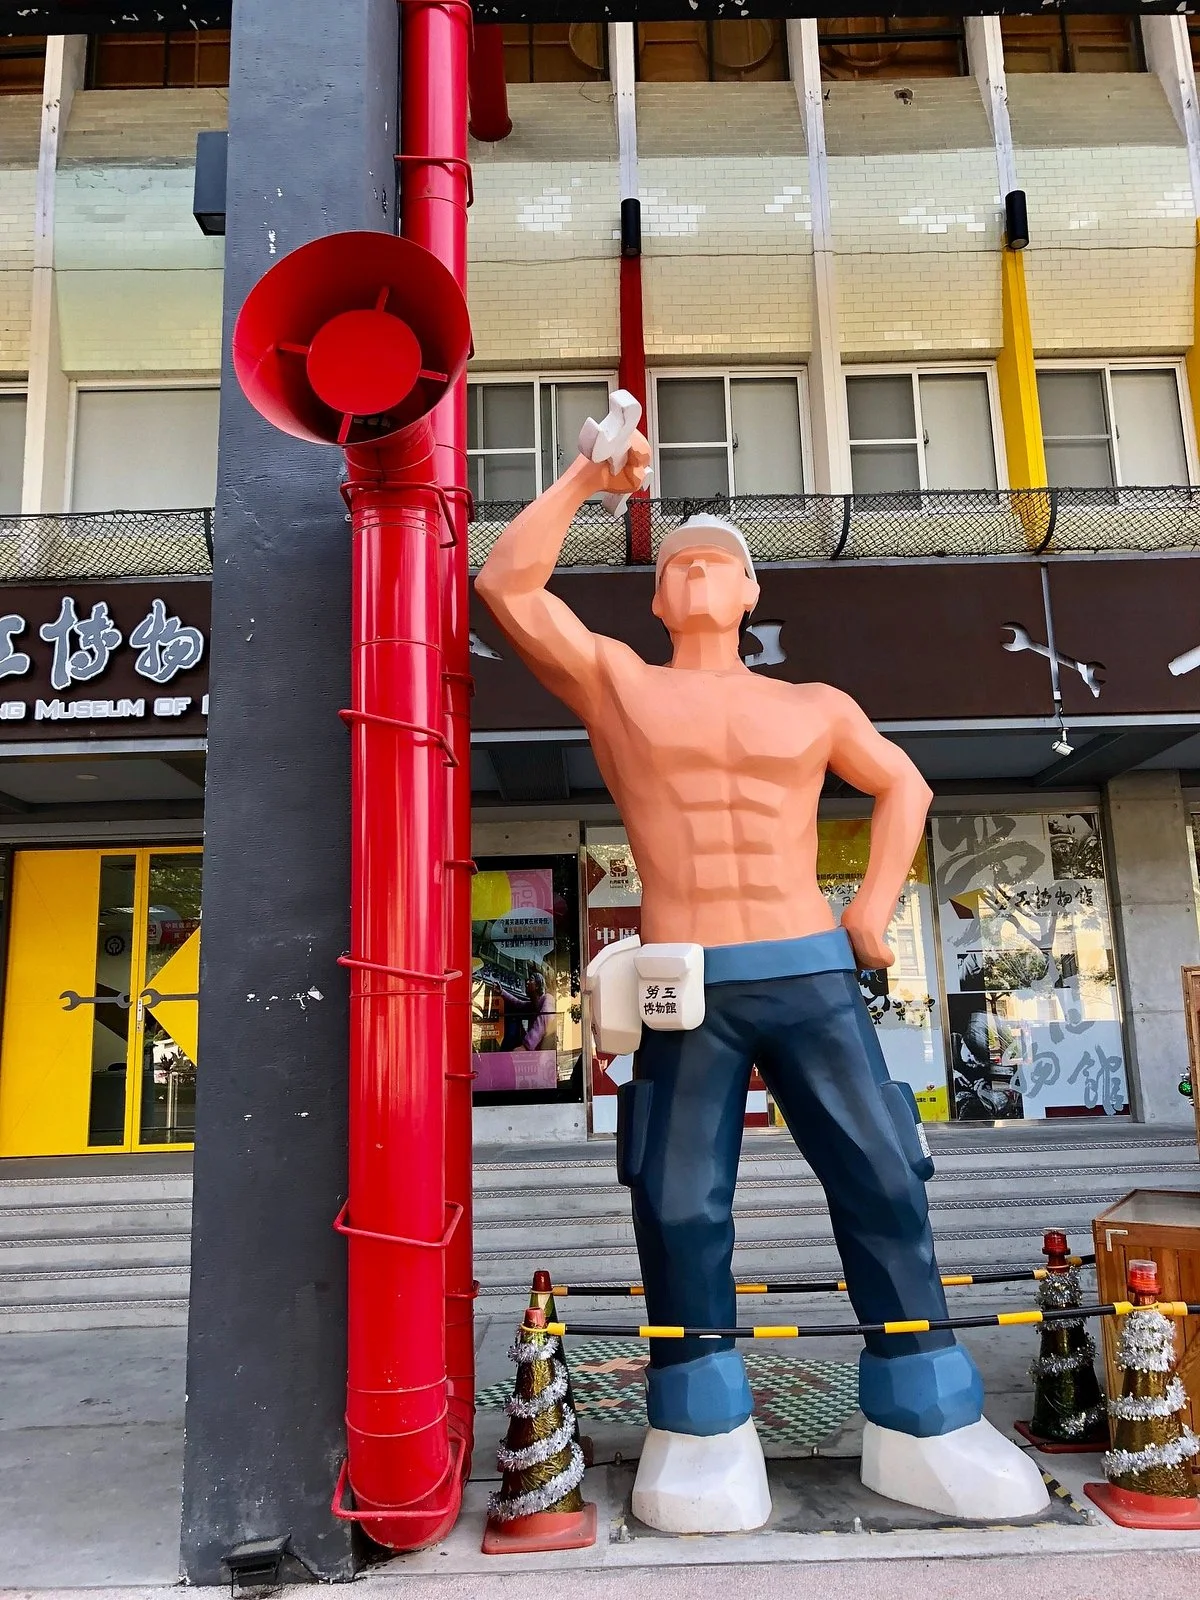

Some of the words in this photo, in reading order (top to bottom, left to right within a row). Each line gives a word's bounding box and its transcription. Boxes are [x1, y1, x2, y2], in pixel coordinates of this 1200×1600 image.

[35, 699, 145, 720] MUSEUM
[154, 697, 192, 716] OF
[643, 1001, 677, 1015] 博物館
